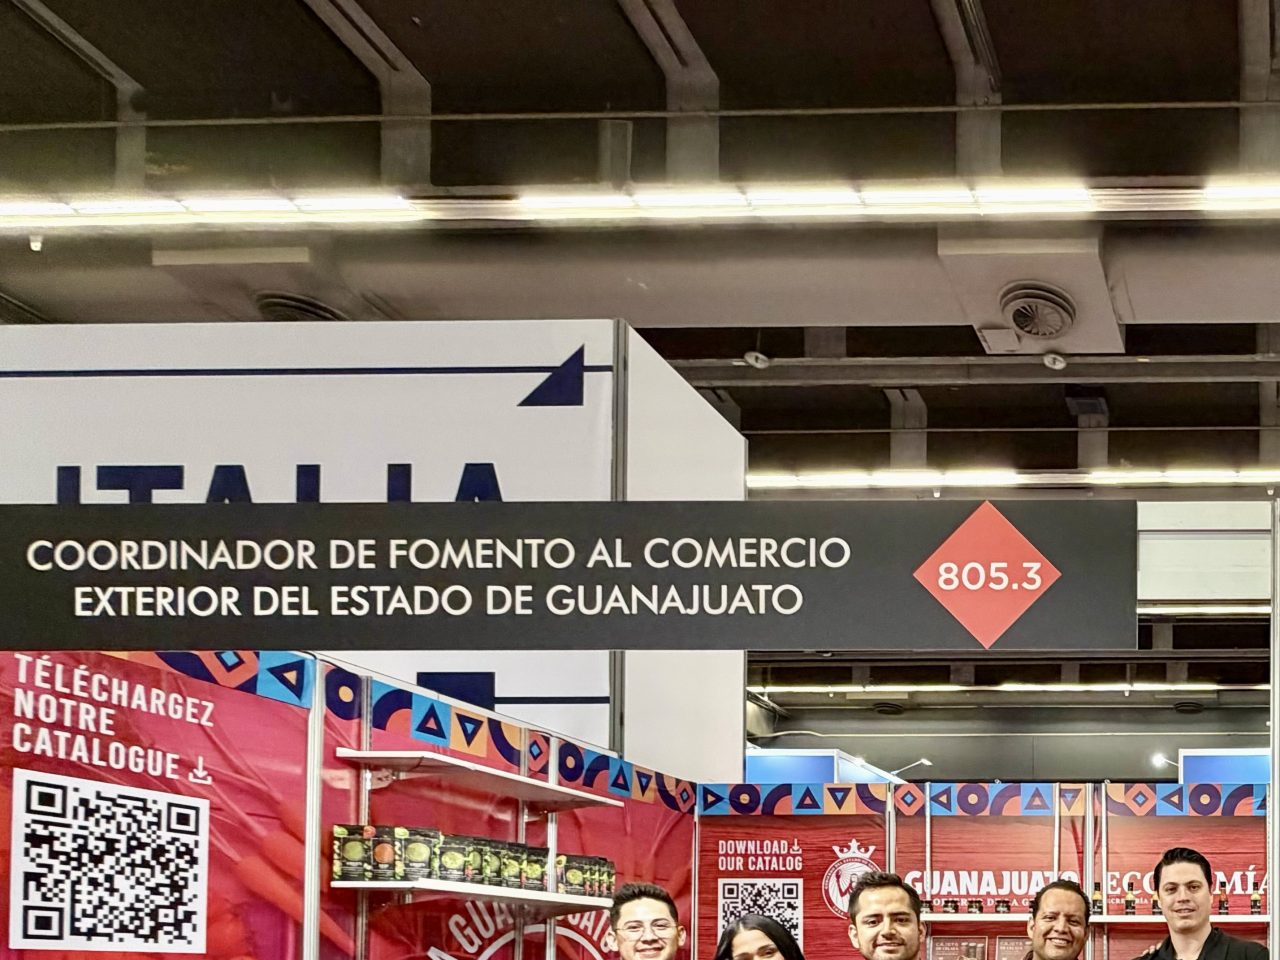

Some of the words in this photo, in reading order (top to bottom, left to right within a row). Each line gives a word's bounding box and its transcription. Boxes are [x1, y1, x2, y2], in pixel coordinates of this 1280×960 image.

[26, 539, 319, 571] COORDINADOR
[329, 539, 376, 570] DE
[389, 537, 576, 570] FOMENTO
[588, 537, 632, 569] AL
[643, 536, 851, 569] COMERCIO
[937, 561, 1042, 591] 805.3
[74, 586, 242, 617] EXTERIOR
[253, 586, 319, 616] DEL
[331, 585, 472, 616] ESTADO
[486, 585, 533, 615] DE
[545, 583, 804, 616] GUANAJUATO
[14, 652, 215, 728] TÉLÉCHARGEZ
[14, 687, 116, 736] NOTRE
[12, 722, 181, 780] CATALOGUE
[718, 840, 789, 855] DOWNLOAD
[718, 856, 744, 871] OUR
[748, 856, 803, 871] CATALOG
